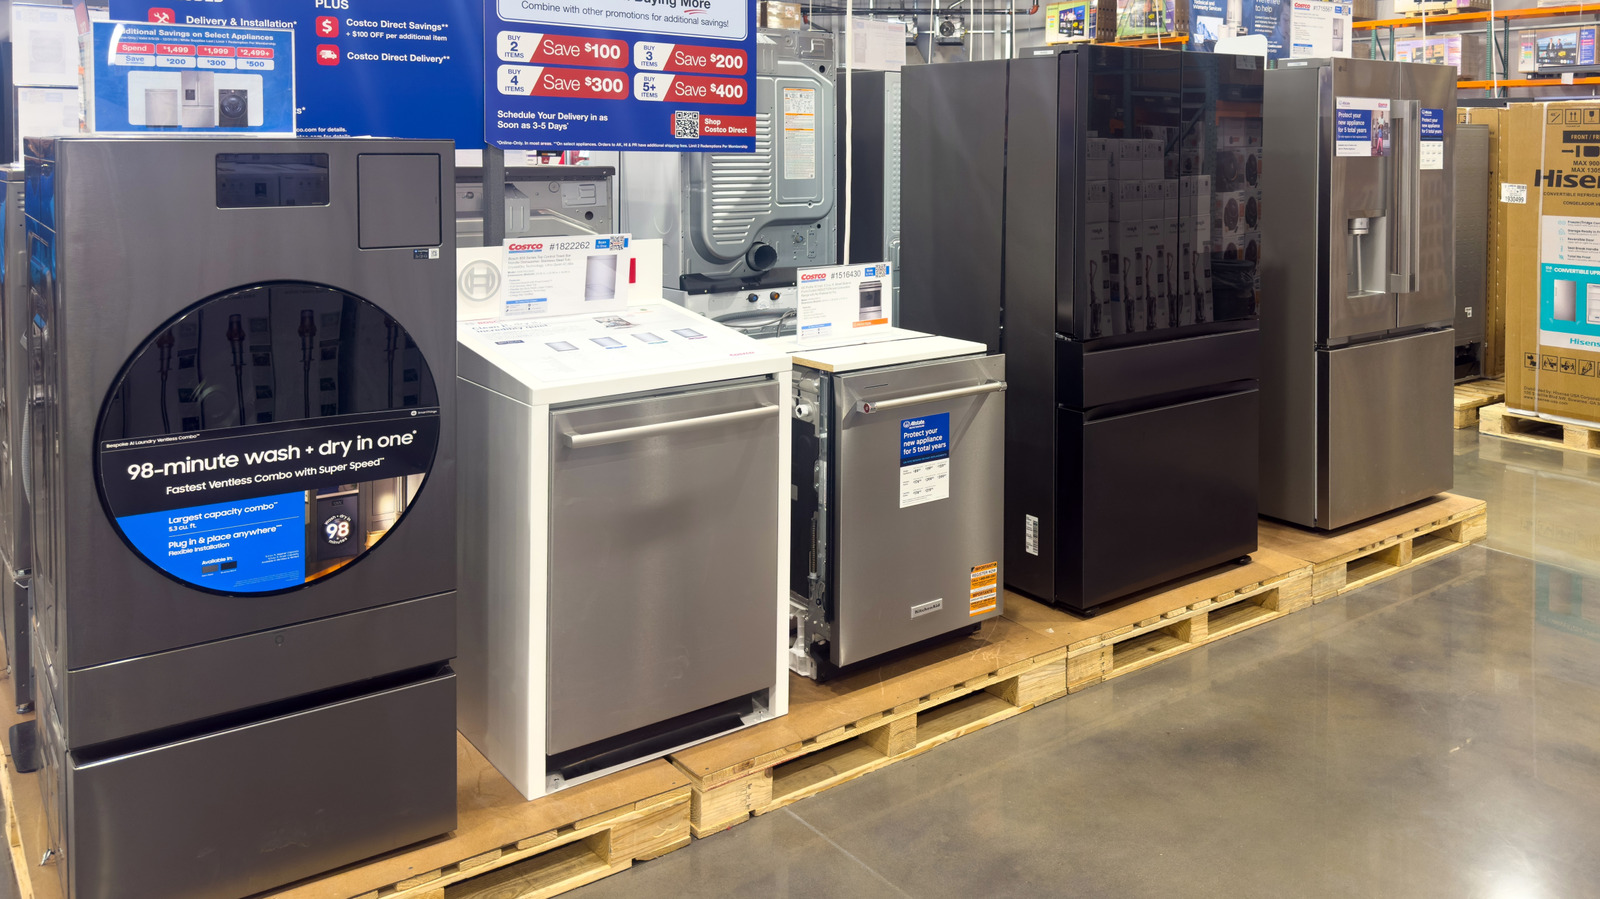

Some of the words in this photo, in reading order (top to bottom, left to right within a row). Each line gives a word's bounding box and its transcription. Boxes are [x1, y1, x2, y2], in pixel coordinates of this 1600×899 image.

[315, 0, 349, 10] PLUS
[521, 0, 560, 12] Combine
[563, 6, 580, 14] with
[582, 7, 603, 16] other
[605, 10, 649, 20] promotions
[663, 14, 699, 25] additional
[701, 19, 729, 28] savings!
[186, 15, 227, 26] Delivery
[230, 18, 238, 26] &
[346, 18, 378, 28] Costco
[380, 20, 407, 29] Direct
[159, 29, 190, 37] Savings
[231, 33, 274, 41] Appliances
[352, 30, 368, 38] $100
[510, 41, 518, 52] 2
[543, 39, 580, 57] Save
[584, 42, 621, 59] $100
[347, 52, 379, 61] Costco
[381, 53, 408, 62] Direct
[646, 51, 653, 61] 3
[674, 51, 706, 67] Save
[710, 53, 743, 69] $200
[510, 75, 519, 86] 4
[543, 74, 580, 91] Save
[584, 76, 623, 93] $300
[642, 82, 656, 92] 5+
[675, 81, 706, 97] Save
[710, 83, 743, 98] $400
[497, 110, 536, 119] Schedule
[537, 111, 556, 119] Your
[558, 112, 589, 122] Delivery
[590, 113, 597, 121] in
[497, 121, 519, 129] Soon
[532, 122, 546, 130] 3-5
[1534, 169, 1600, 189] Hise
[508, 243, 543, 251] COSTCO
[549, 241, 590, 250] #1822262
[801, 273, 827, 281] COSTCO
[831, 270, 861, 279] #1516430
[903, 430, 925, 439] Protect
[925, 428, 938, 436] your
[916, 435, 943, 445] appliance
[917, 444, 931, 452] total
[931, 442, 947, 451] years
[127, 453, 239, 481] 98-minute
[244, 445, 301, 465] wash
[305, 446, 314, 454] +
[318, 440, 352, 458] dry
[357, 435, 373, 451] in
[166, 482, 206, 495] Fastest
[208, 476, 252, 489] Ventless
[254, 471, 292, 483] Combo
[295, 467, 317, 477] with
[319, 464, 347, 475] Super
[168, 513, 202, 525] Largest
[204, 507, 242, 520] capacity
[324, 515, 337, 525] wash
[326, 521, 350, 539] 98
[168, 540, 187, 549] Plug
[198, 536, 206, 544] &
[207, 533, 231, 545] place
[168, 548, 193, 557] Flexible
[194, 542, 230, 552] Installation
[201, 557, 226, 565] Available
